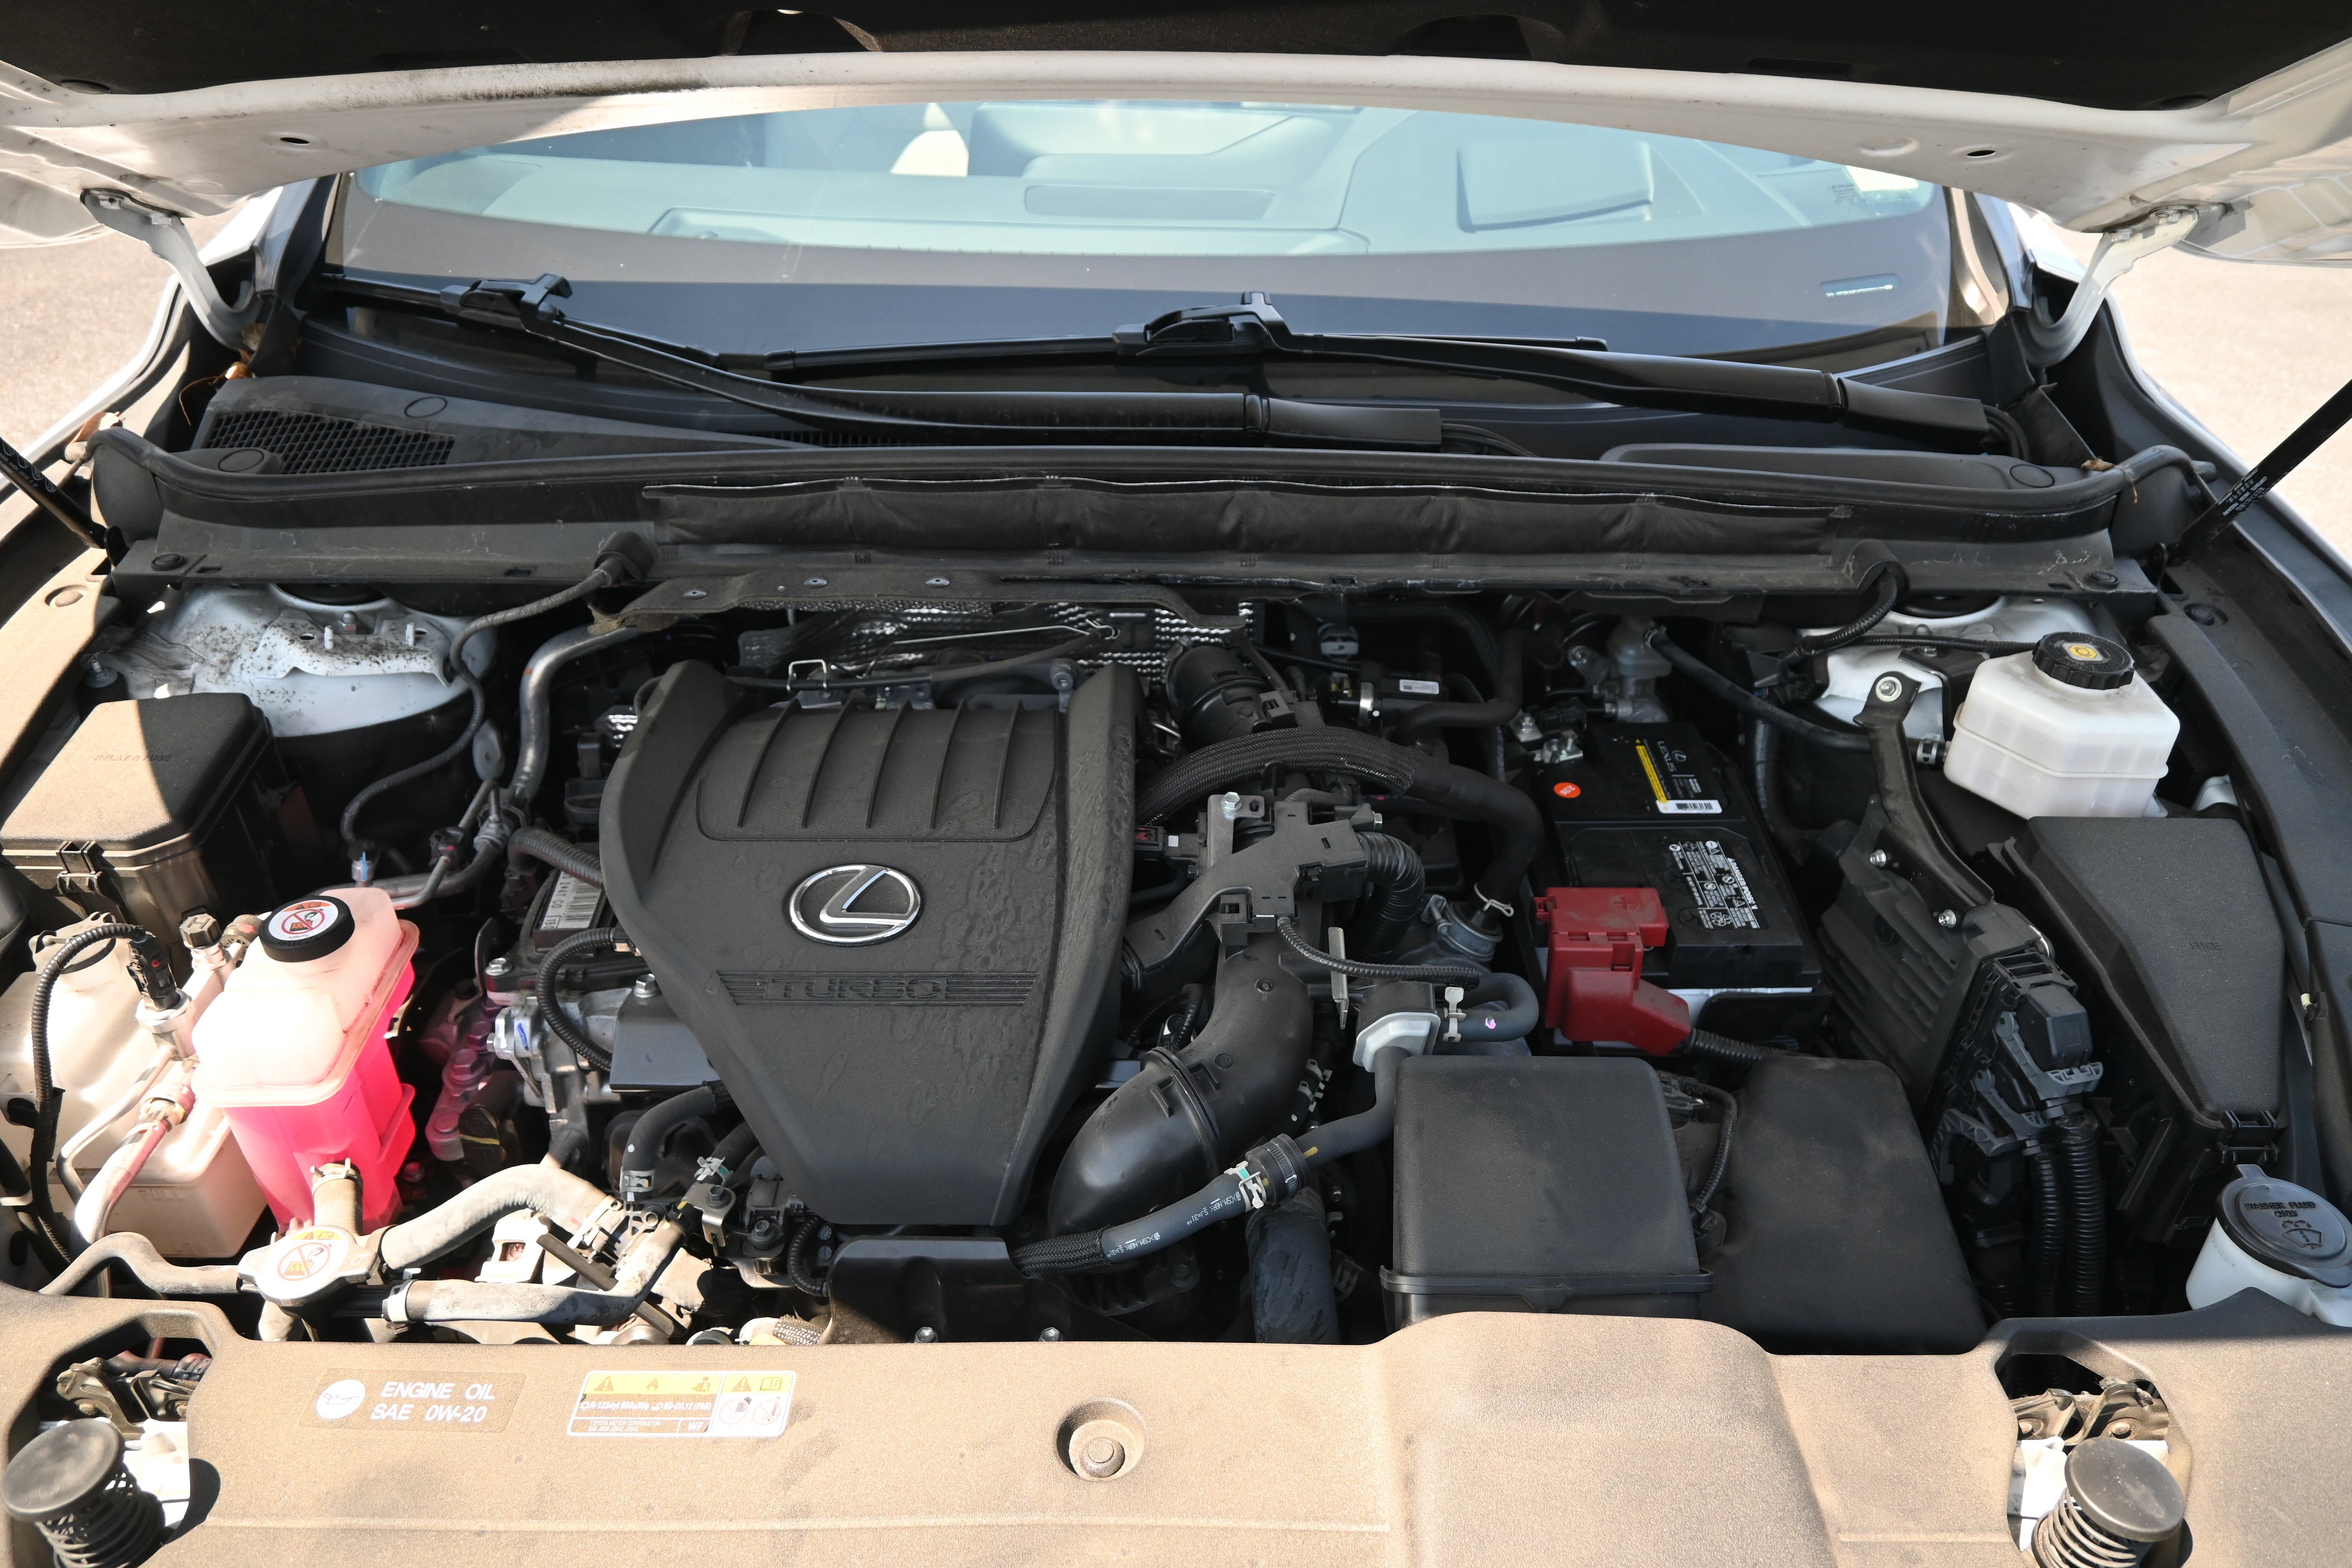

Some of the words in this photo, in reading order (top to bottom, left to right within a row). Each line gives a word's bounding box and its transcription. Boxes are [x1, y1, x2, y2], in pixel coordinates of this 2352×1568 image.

[1657, 741, 1677, 772] LEXUS
[1730, 862, 1746, 886] DANGER
[2189, 940, 2222, 950] FUSE
[772, 978, 942, 999] TURBO
[380, 1381, 455, 1399] ENGINE
[465, 1383, 495, 1400] OIL
[370, 1403, 415, 1420] SAE
[425, 1404, 488, 1423] 0W-20
[688, 1421, 704, 1431] WF
